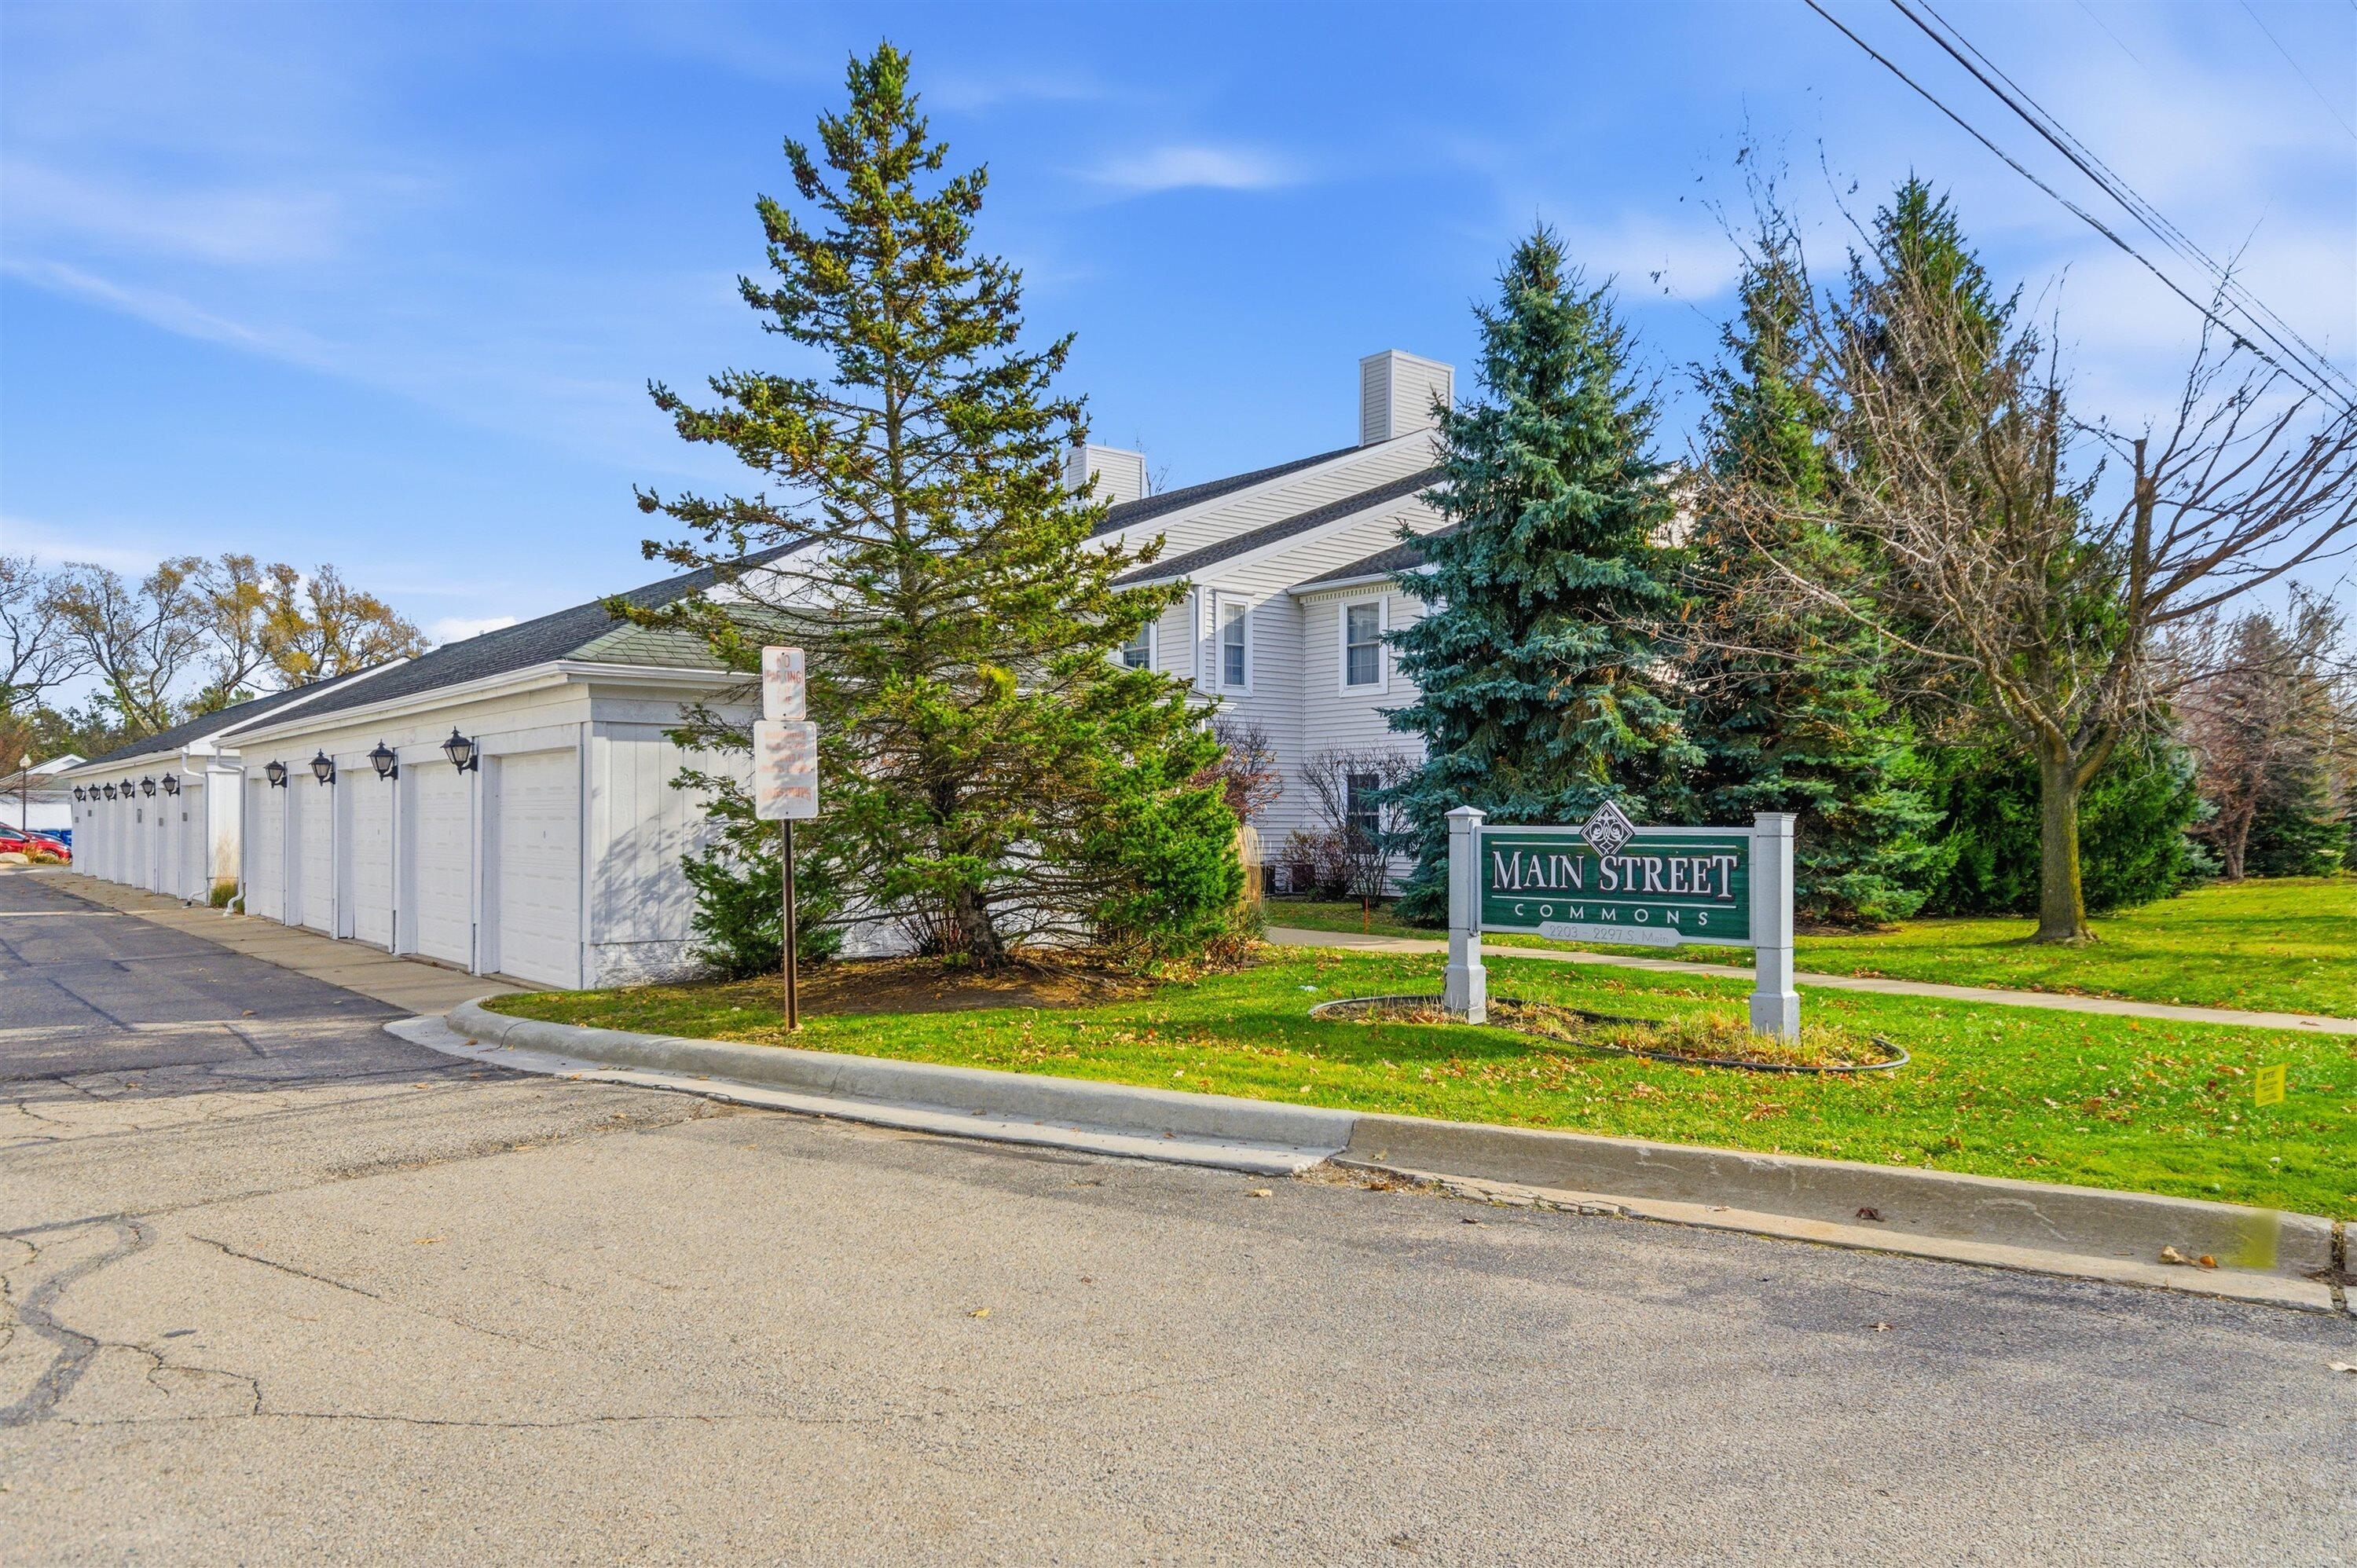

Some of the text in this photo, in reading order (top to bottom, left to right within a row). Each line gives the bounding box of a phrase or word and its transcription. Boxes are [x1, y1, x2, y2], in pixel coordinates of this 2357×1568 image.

[1492, 851, 1737, 898] MAIN STREET
[1515, 903, 1709, 925] COMMONS
[1549, 925, 1578, 938] 2203
[1593, 927, 1622, 940] 2297
[1627, 929, 1637, 942] S.
